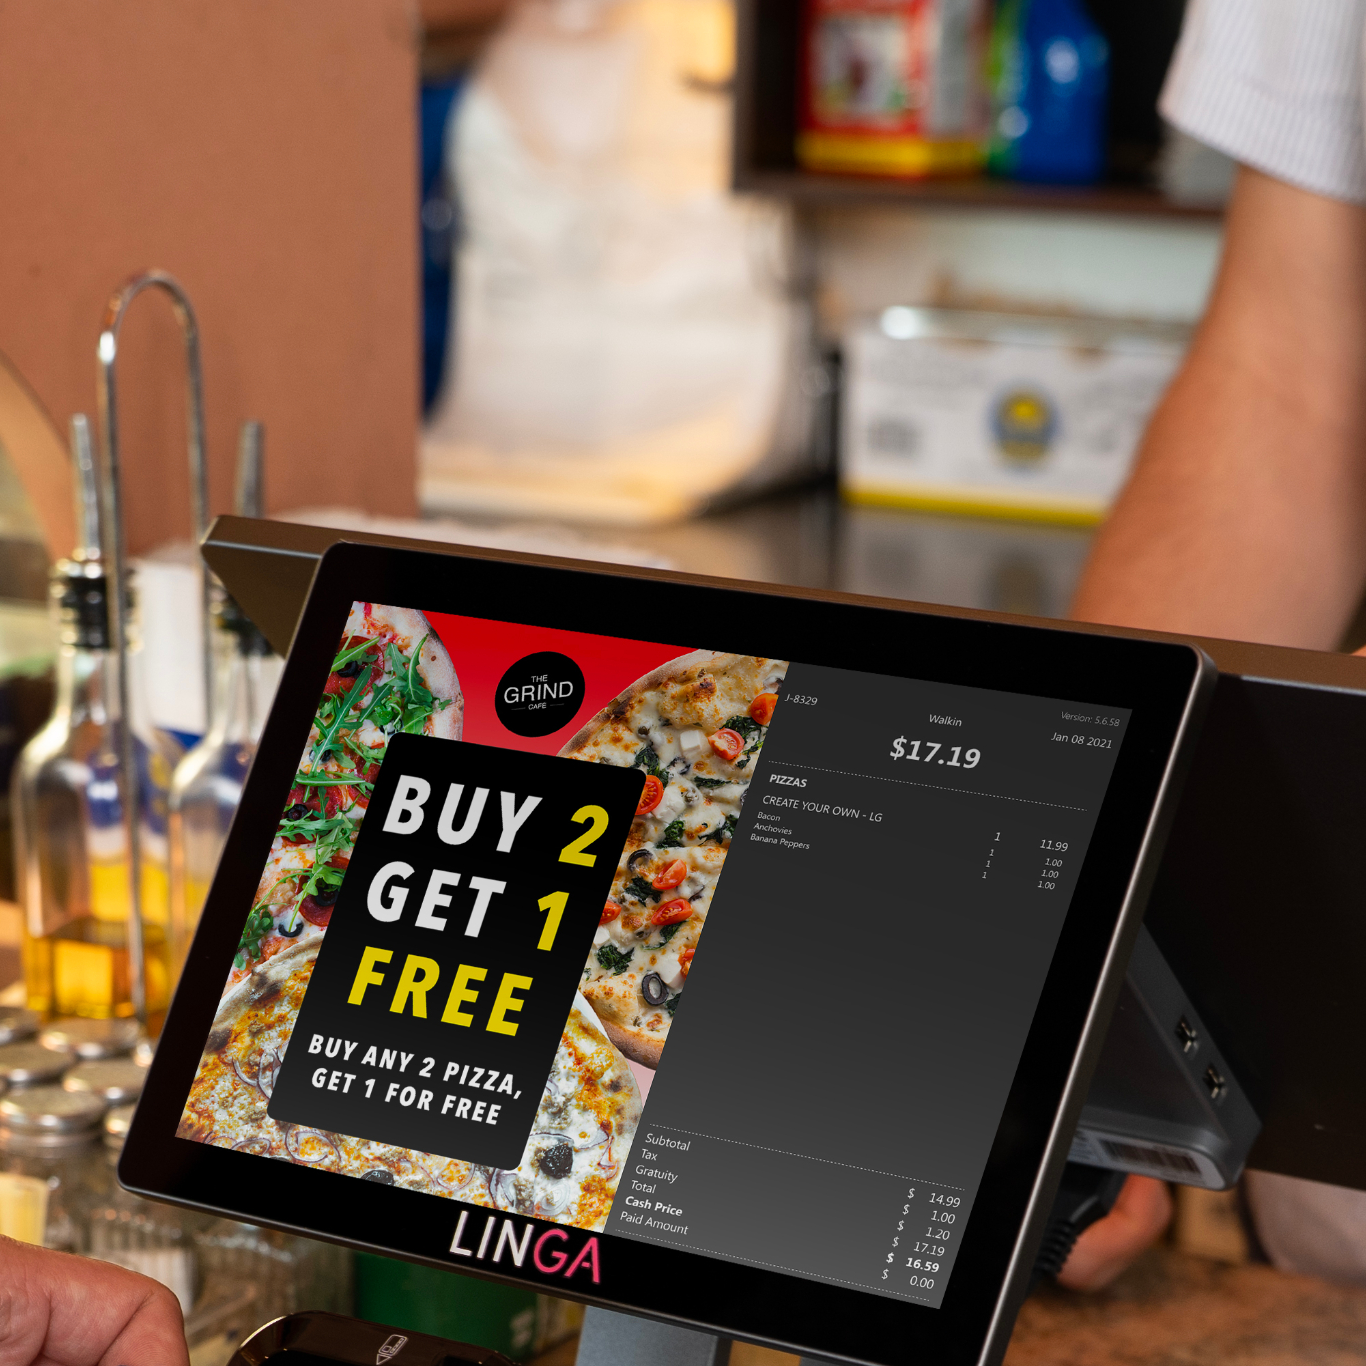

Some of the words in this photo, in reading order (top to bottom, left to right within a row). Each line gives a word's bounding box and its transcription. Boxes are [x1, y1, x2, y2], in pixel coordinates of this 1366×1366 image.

[503, 680, 574, 704] GRIND
[531, 674, 548, 683] THE
[784, 693, 818, 706] J-8329
[929, 713, 963, 727] Walkin
[1050, 732, 1069, 743] Jan
[1071, 734, 1085, 745] 08
[1086, 736, 1112, 749] 2021
[1061, 711, 1093, 723] Version:
[1094, 715, 1121, 727] 5.6.58
[768, 773, 808, 788] PIZZAS
[889, 735, 981, 769] $17.19
[382, 774, 543, 853] BUY
[558, 804, 609, 868] 2
[757, 811, 781, 822] Bacon
[989, 848, 995, 857] 1
[1044, 857, 1063, 868] 1.00
[762, 794, 800, 809] CREATE
[802, 800, 831, 814] YOUR
[832, 806, 861, 819] OWN
[868, 811, 883, 823] LG
[994, 831, 1001, 842] 1
[1039, 839, 1069, 852] 11.99
[750, 833, 778, 845] Banana
[779, 837, 810, 850] Peppers
[981, 871, 987, 879] 1
[1037, 880, 1056, 890] 1.00
[753, 822, 793, 835] Anchovies
[985, 860, 991, 868] 1
[1041, 869, 1060, 879] 1.00
[366, 860, 507, 938] GET
[536, 890, 570, 952] 1
[347, 945, 534, 1037] FREE
[307, 1033, 359, 1061] BUY
[360, 1045, 415, 1073] ANY
[418, 1056, 436, 1078] 2
[442, 1061, 522, 1100] PIZZA,
[311, 1067, 357, 1094] GET
[364, 1078, 376, 1099] 1
[384, 1082, 434, 1112] FOR
[440, 1094, 502, 1126] FREE
[641, 1148, 658, 1161] Tax
[902, 1203, 910, 1215] $
[931, 1210, 956, 1224] 1.00
[645, 1133, 691, 1151] Subtotal
[907, 1187, 916, 1200] $
[929, 1192, 961, 1208] 14.99
[630, 1180, 657, 1194] Total
[891, 1235, 900, 1248] $
[913, 1241, 946, 1257] 17.19
[635, 1164, 679, 1184] Gratuity
[897, 1219, 905, 1231] $
[925, 1226, 951, 1241] 1.20
[449, 1210, 600, 1283] LINGA
[619, 1211, 644, 1225] Paid
[644, 1217, 689, 1235] Amount
[881, 1268, 890, 1280] $
[909, 1275, 935, 1290] 0.00
[625, 1196, 652, 1210] Cash
[654, 1201, 683, 1217] Price
[885, 1251, 895, 1264] $
[905, 1257, 940, 1273] 16.59
